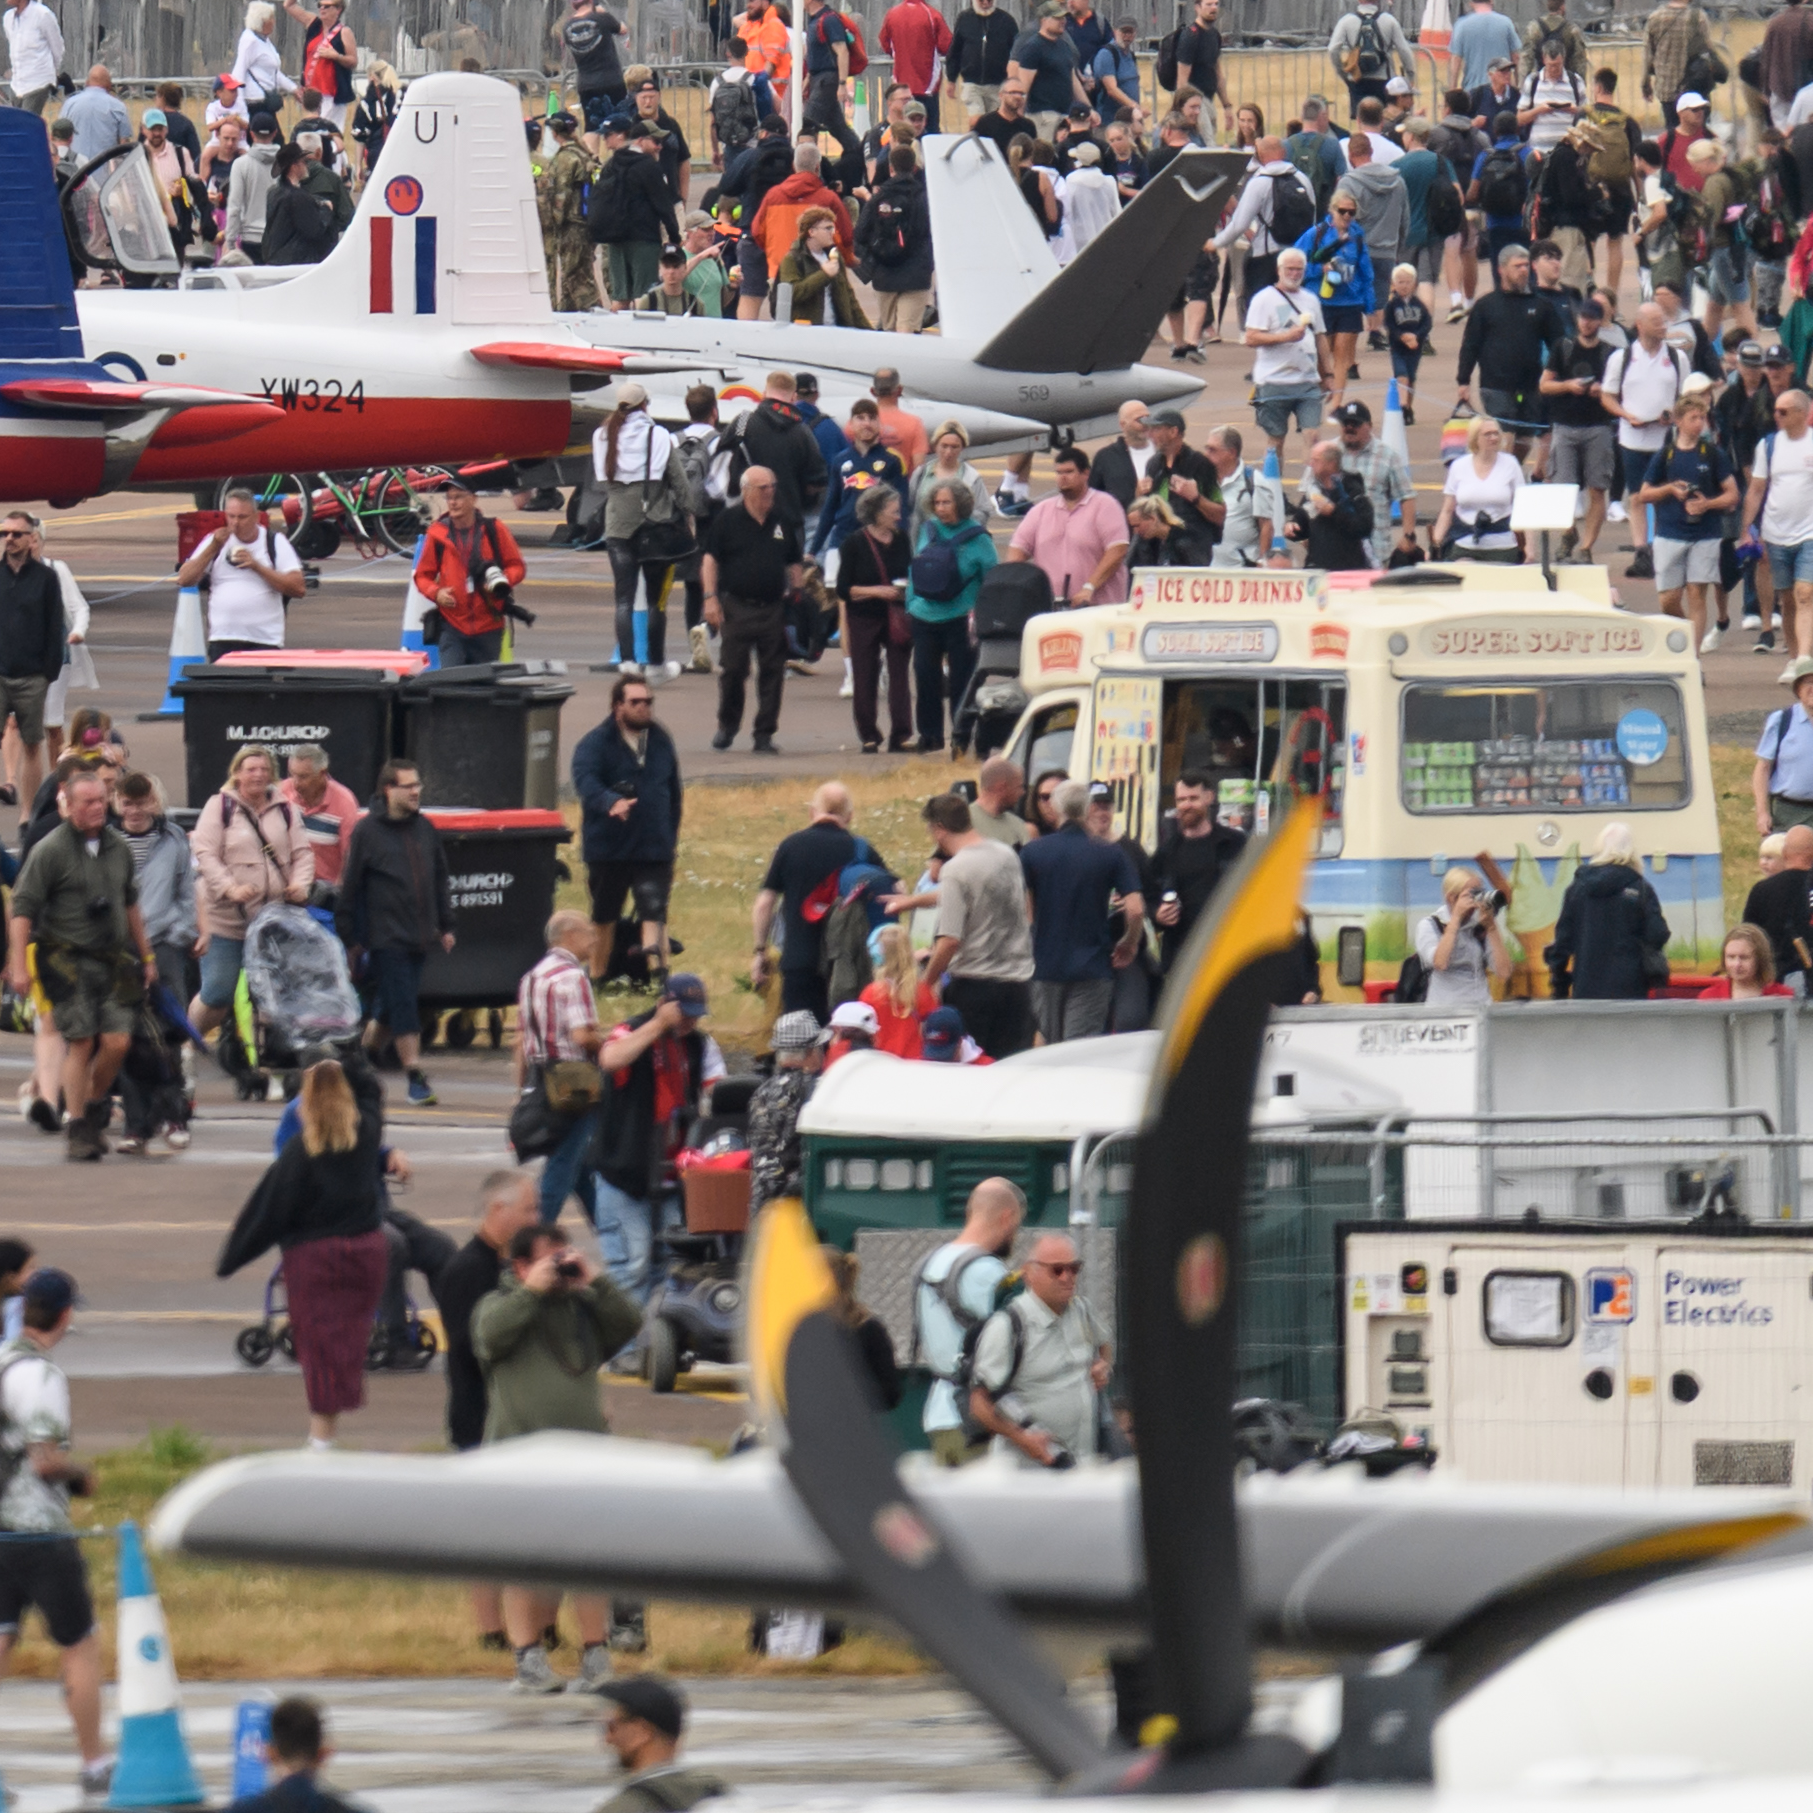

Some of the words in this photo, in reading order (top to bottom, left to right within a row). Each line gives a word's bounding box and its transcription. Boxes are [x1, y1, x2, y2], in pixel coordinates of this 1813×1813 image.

[414, 110, 439, 145] U
[260, 377, 366, 413] XW324
[1018, 384, 1050, 403] 569
[1156, 577, 1184, 603] ICE
[1190, 578, 1234, 604] COLD
[1239, 578, 1305, 604] DRINKS
[1432, 628, 1521, 654] SUPER
[1526, 628, 1595, 653] SOFT
[1598, 627, 1644, 652] ICE
[1665, 1269, 1746, 1296] Power
[1665, 1298, 1774, 1327] Electrics
